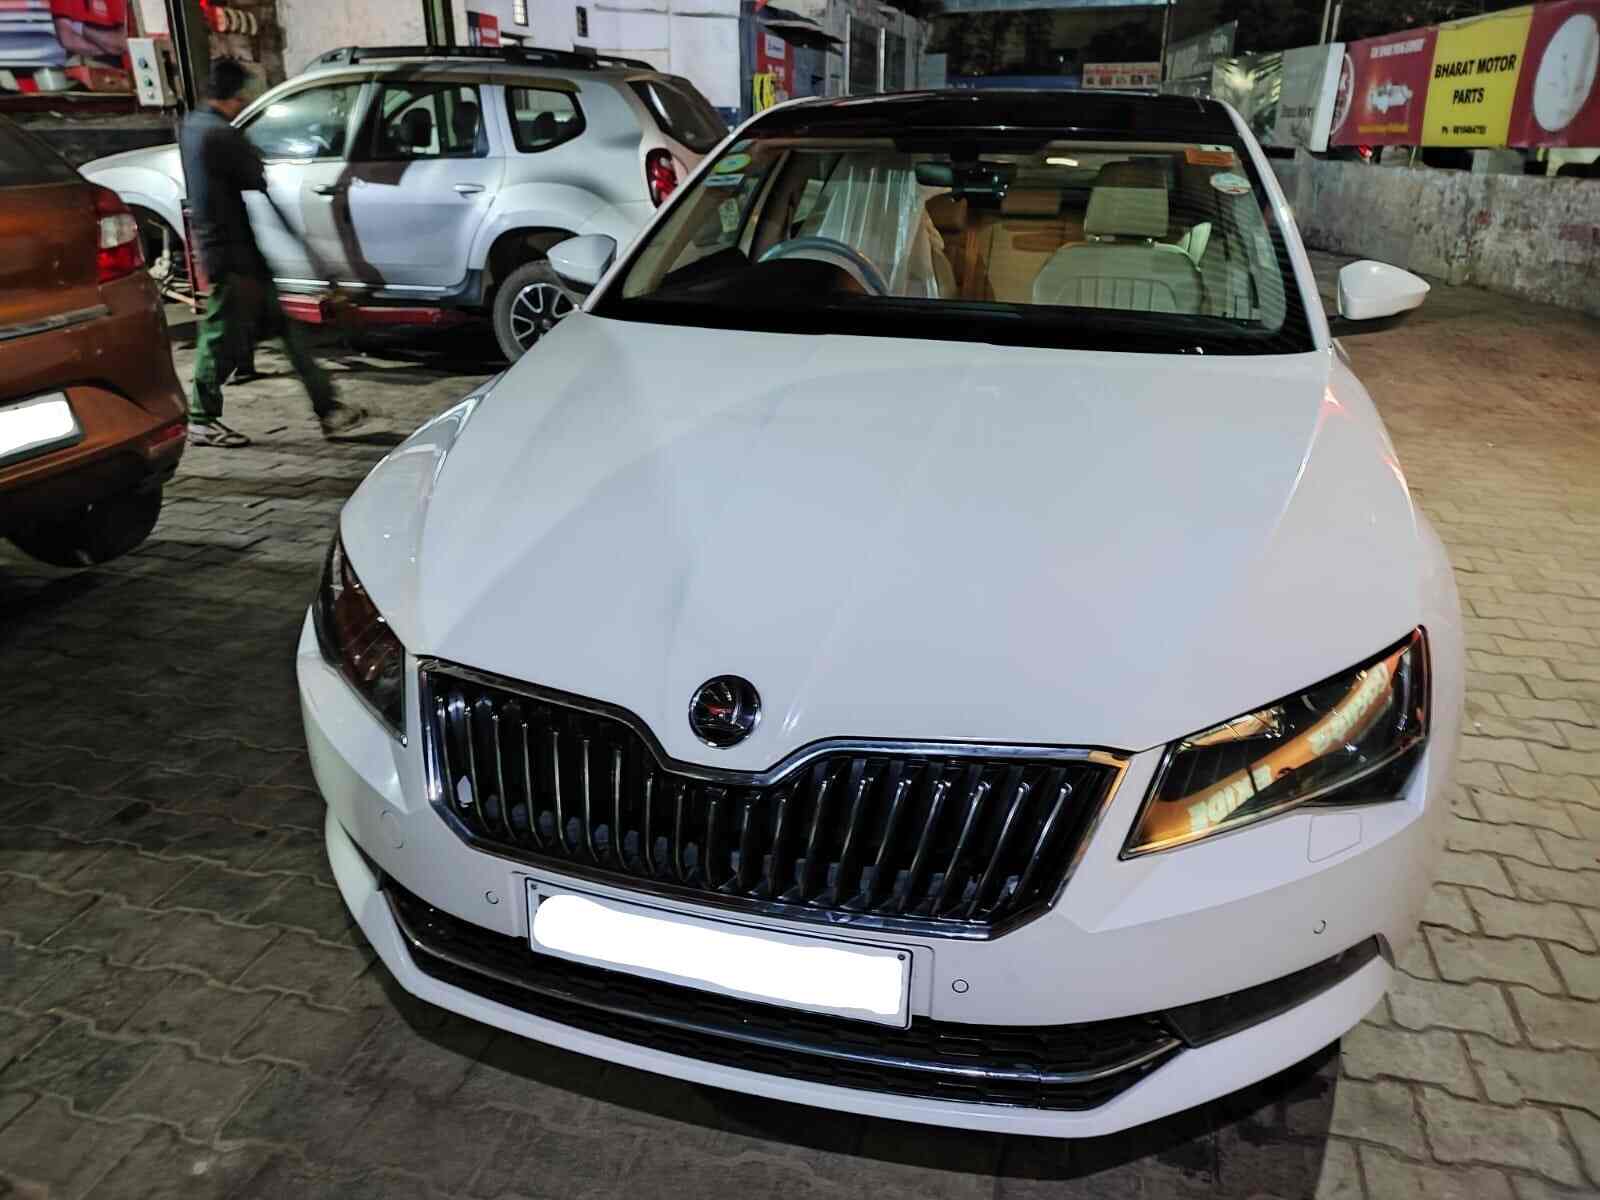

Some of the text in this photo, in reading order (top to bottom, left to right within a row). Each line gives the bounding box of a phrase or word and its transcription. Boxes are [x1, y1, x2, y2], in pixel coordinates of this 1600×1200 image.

[1434, 54, 1517, 78] BHARAT MOTOR
[1452, 87, 1485, 105] PARTS
